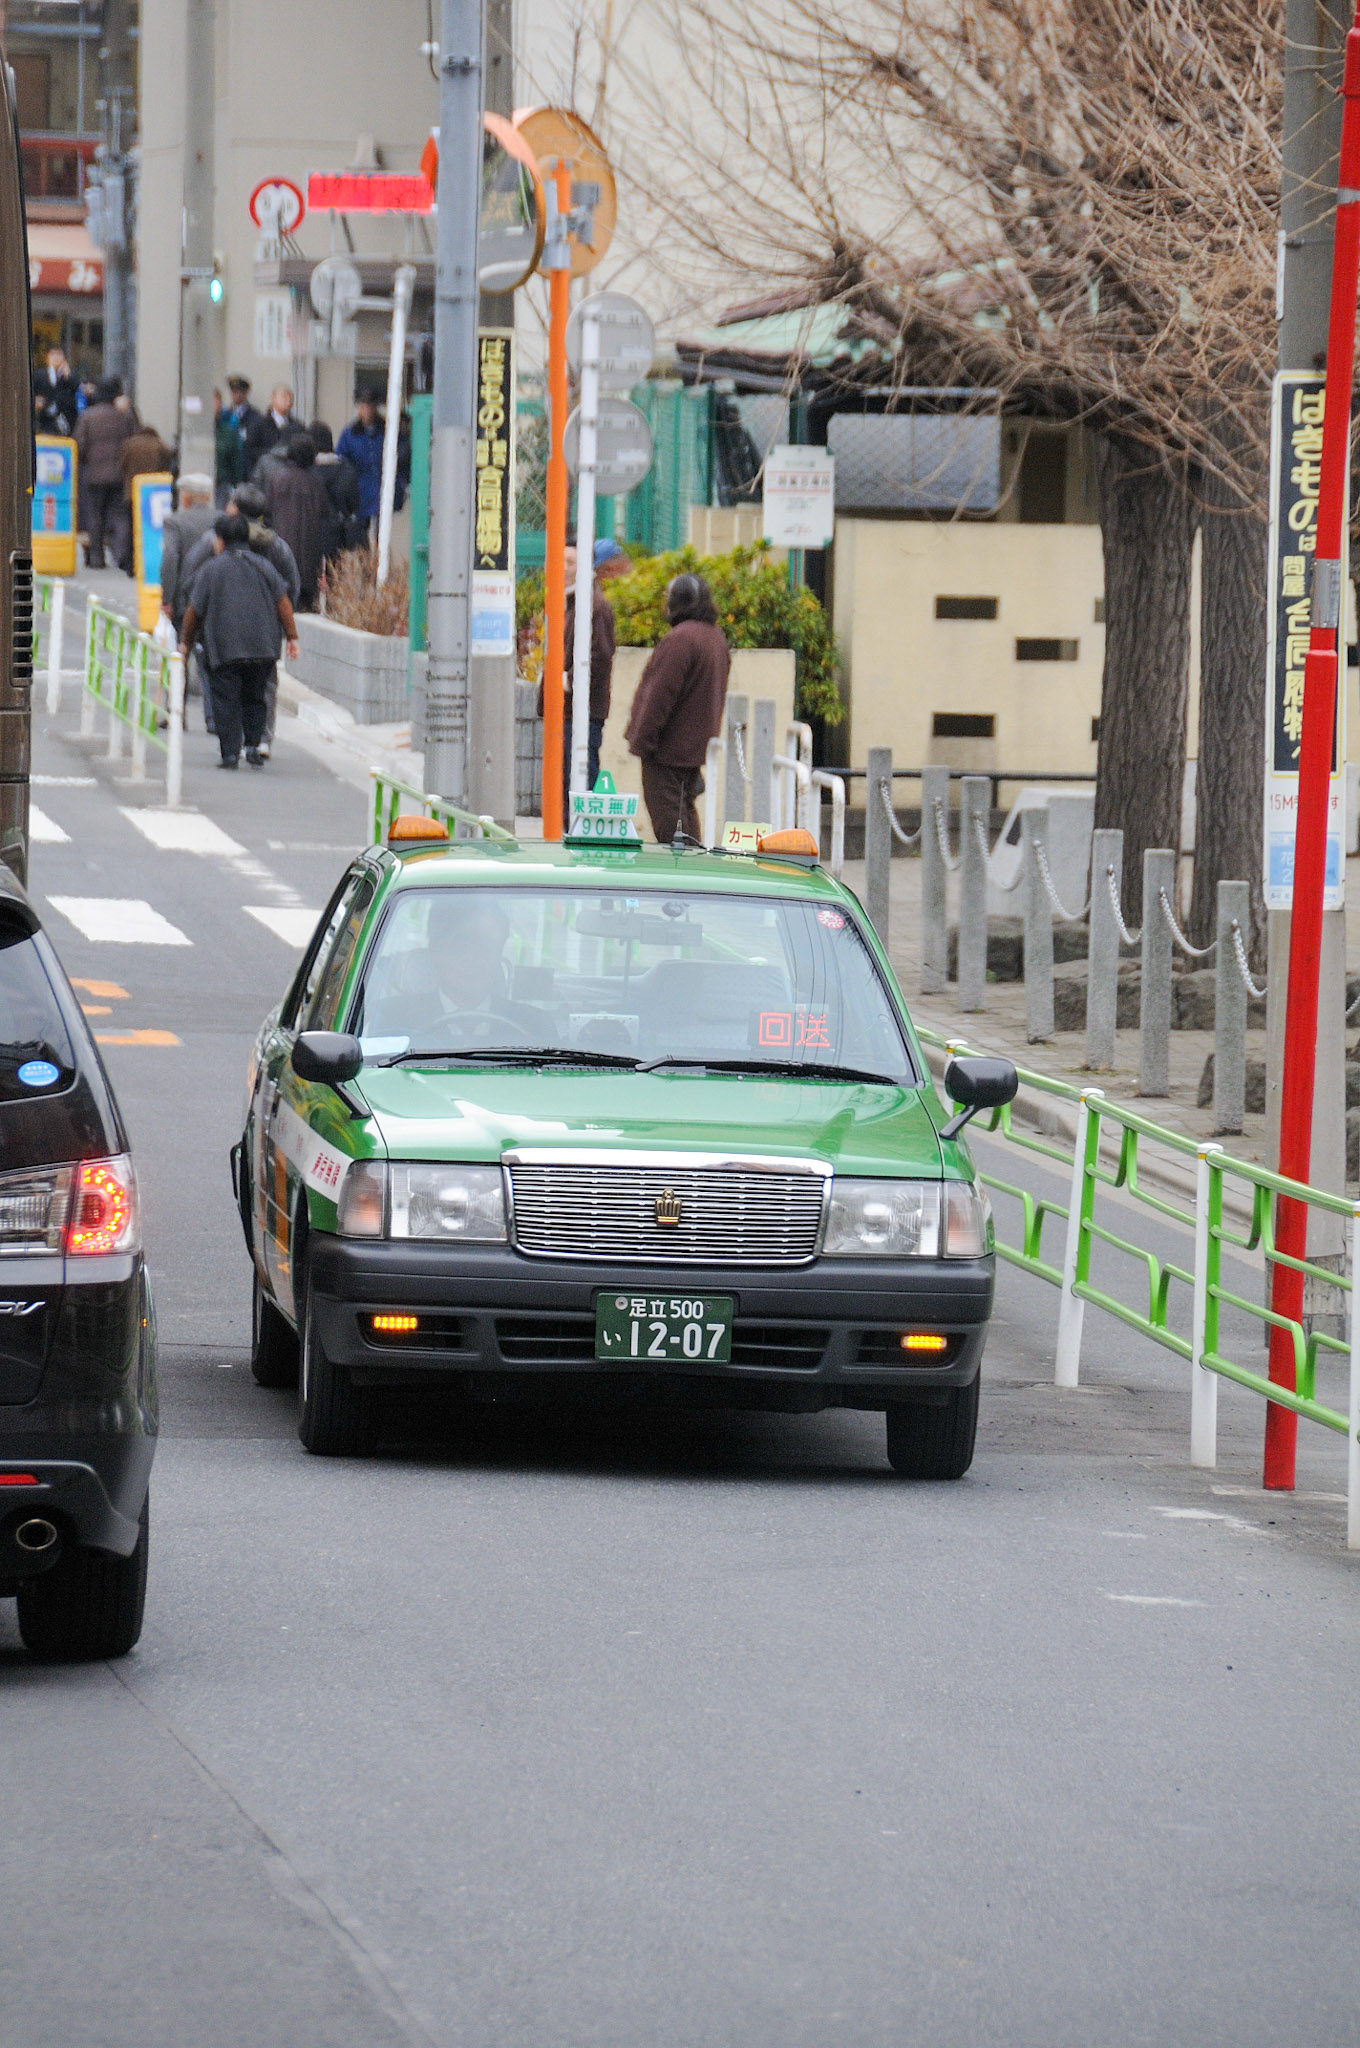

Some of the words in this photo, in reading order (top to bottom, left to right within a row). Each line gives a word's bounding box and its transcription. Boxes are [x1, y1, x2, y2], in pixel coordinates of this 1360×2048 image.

[601, 775, 609, 790] 1
[573, 795, 637, 815] 東京無線
[582, 817, 628, 837] 9018
[729, 826, 767, 845] カード
[758, 1011, 831, 1048] 回送
[629, 1298, 667, 1319] 足立
[670, 1299, 704, 1320] 500
[603, 1330, 622, 1346] い
[630, 1320, 726, 1359] 12-07
